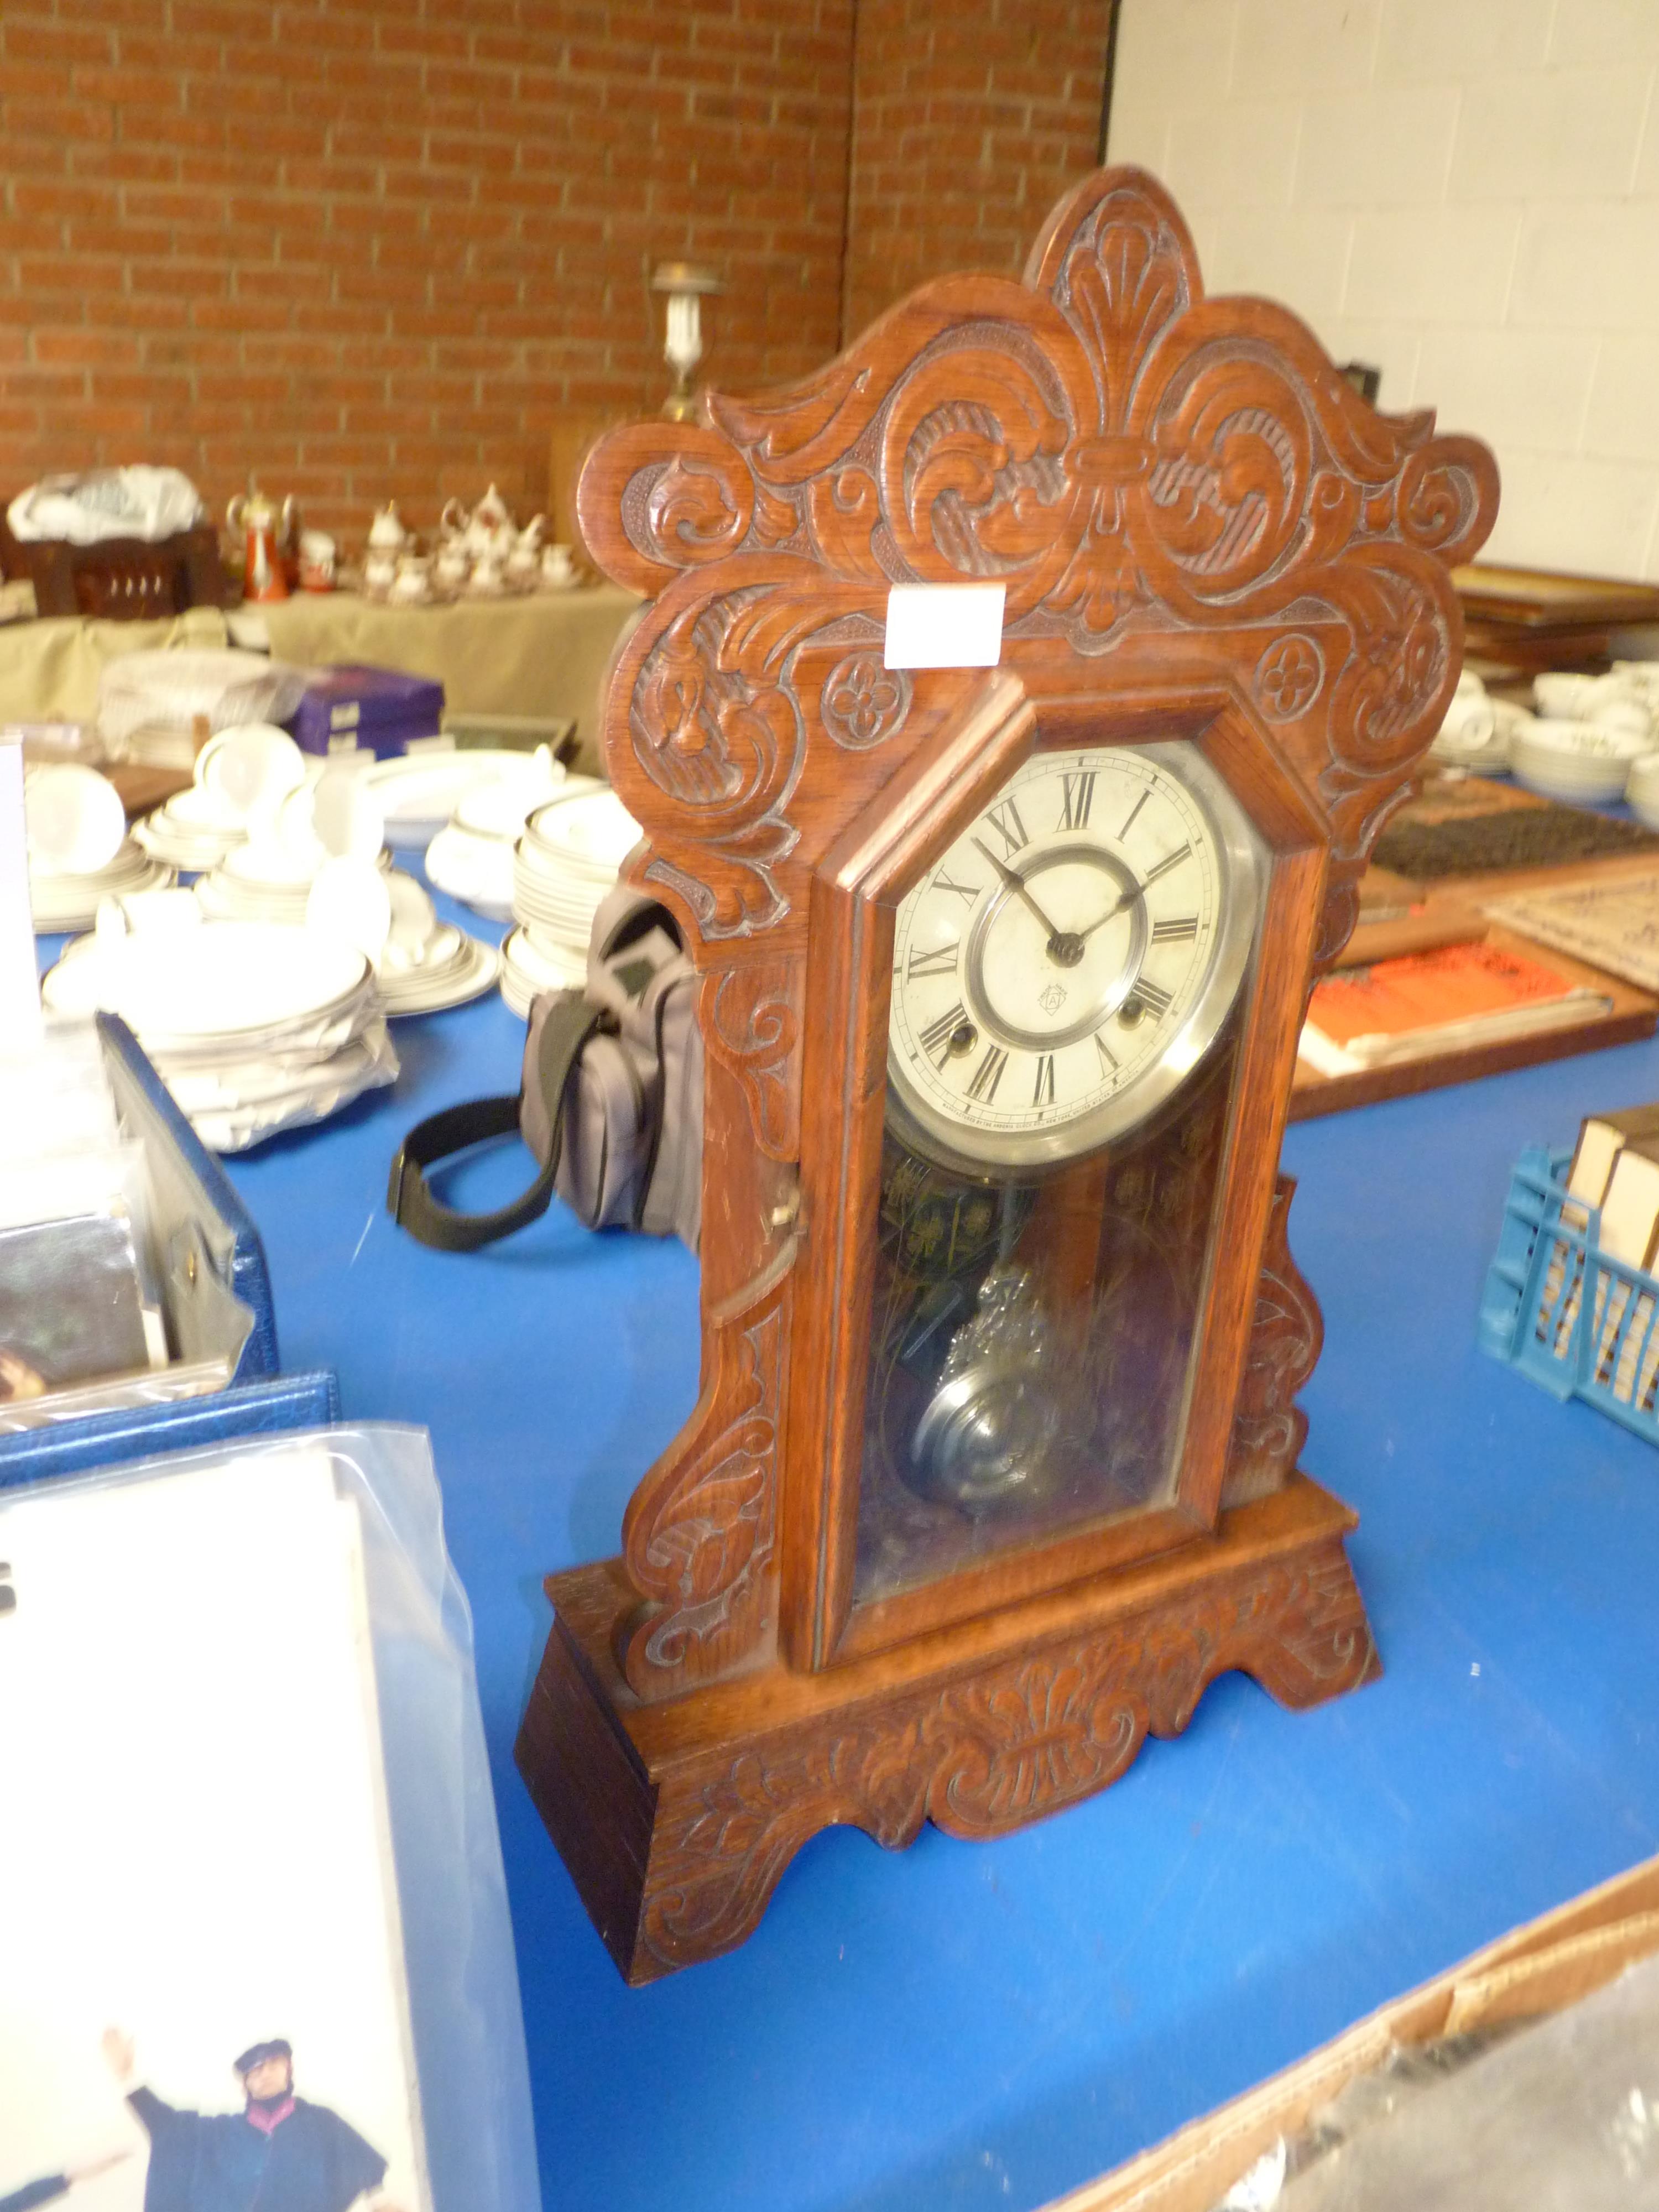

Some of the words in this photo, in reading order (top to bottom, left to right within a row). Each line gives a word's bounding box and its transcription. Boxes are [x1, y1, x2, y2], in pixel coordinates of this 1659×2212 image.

[1052, 771, 1101, 833] XII
[1114, 787, 1155, 845] I
[981, 794, 1034, 863] XI
[926, 864, 985, 912] X
[1144, 838, 1193, 889] II
[1149, 912, 1199, 949] III
[907, 936, 962, 985] IX
[962, 1042, 1009, 1107] VII
[1029, 1054, 1058, 1108] VI
[1093, 1032, 1123, 1081] V
